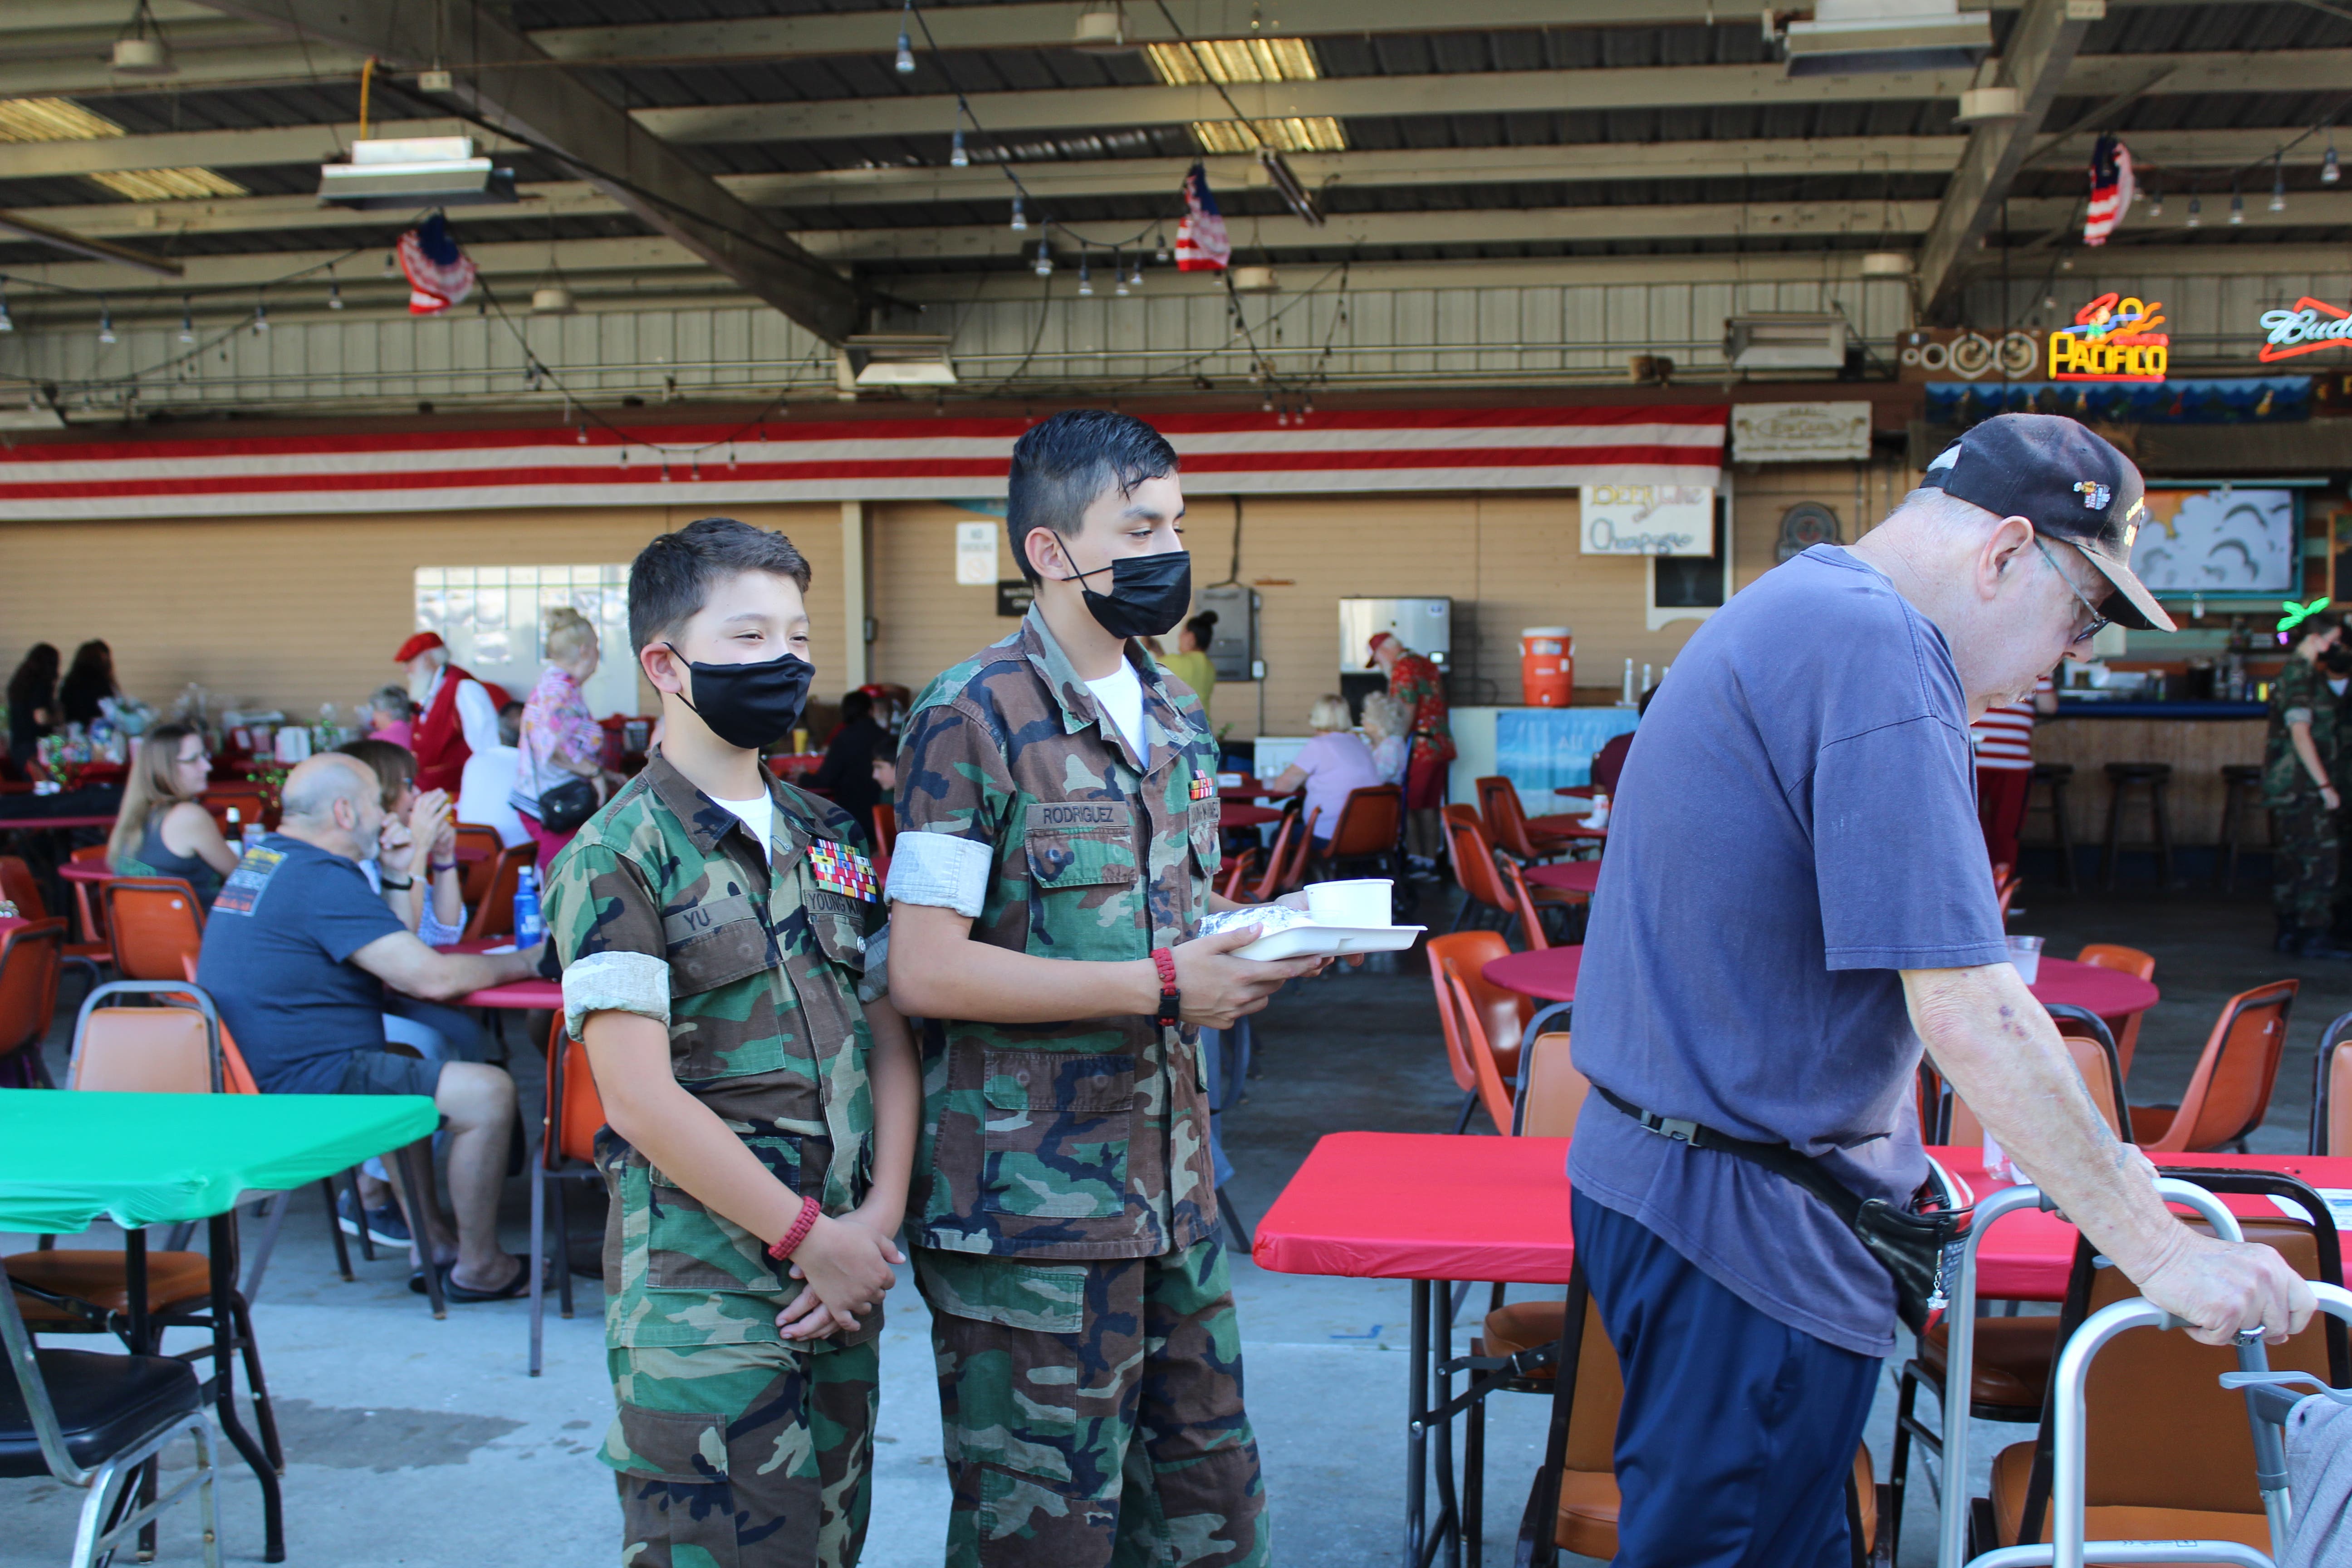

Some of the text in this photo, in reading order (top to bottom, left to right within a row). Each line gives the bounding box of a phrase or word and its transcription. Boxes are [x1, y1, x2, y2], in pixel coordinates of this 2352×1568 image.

[2260, 309, 2352, 345] Bud
[2049, 331, 2167, 380] PACIFICO
[1044, 807, 1114, 824] RODRIGUEZ
[808, 892, 846, 913] YOUNG
[683, 908, 711, 930] YU
